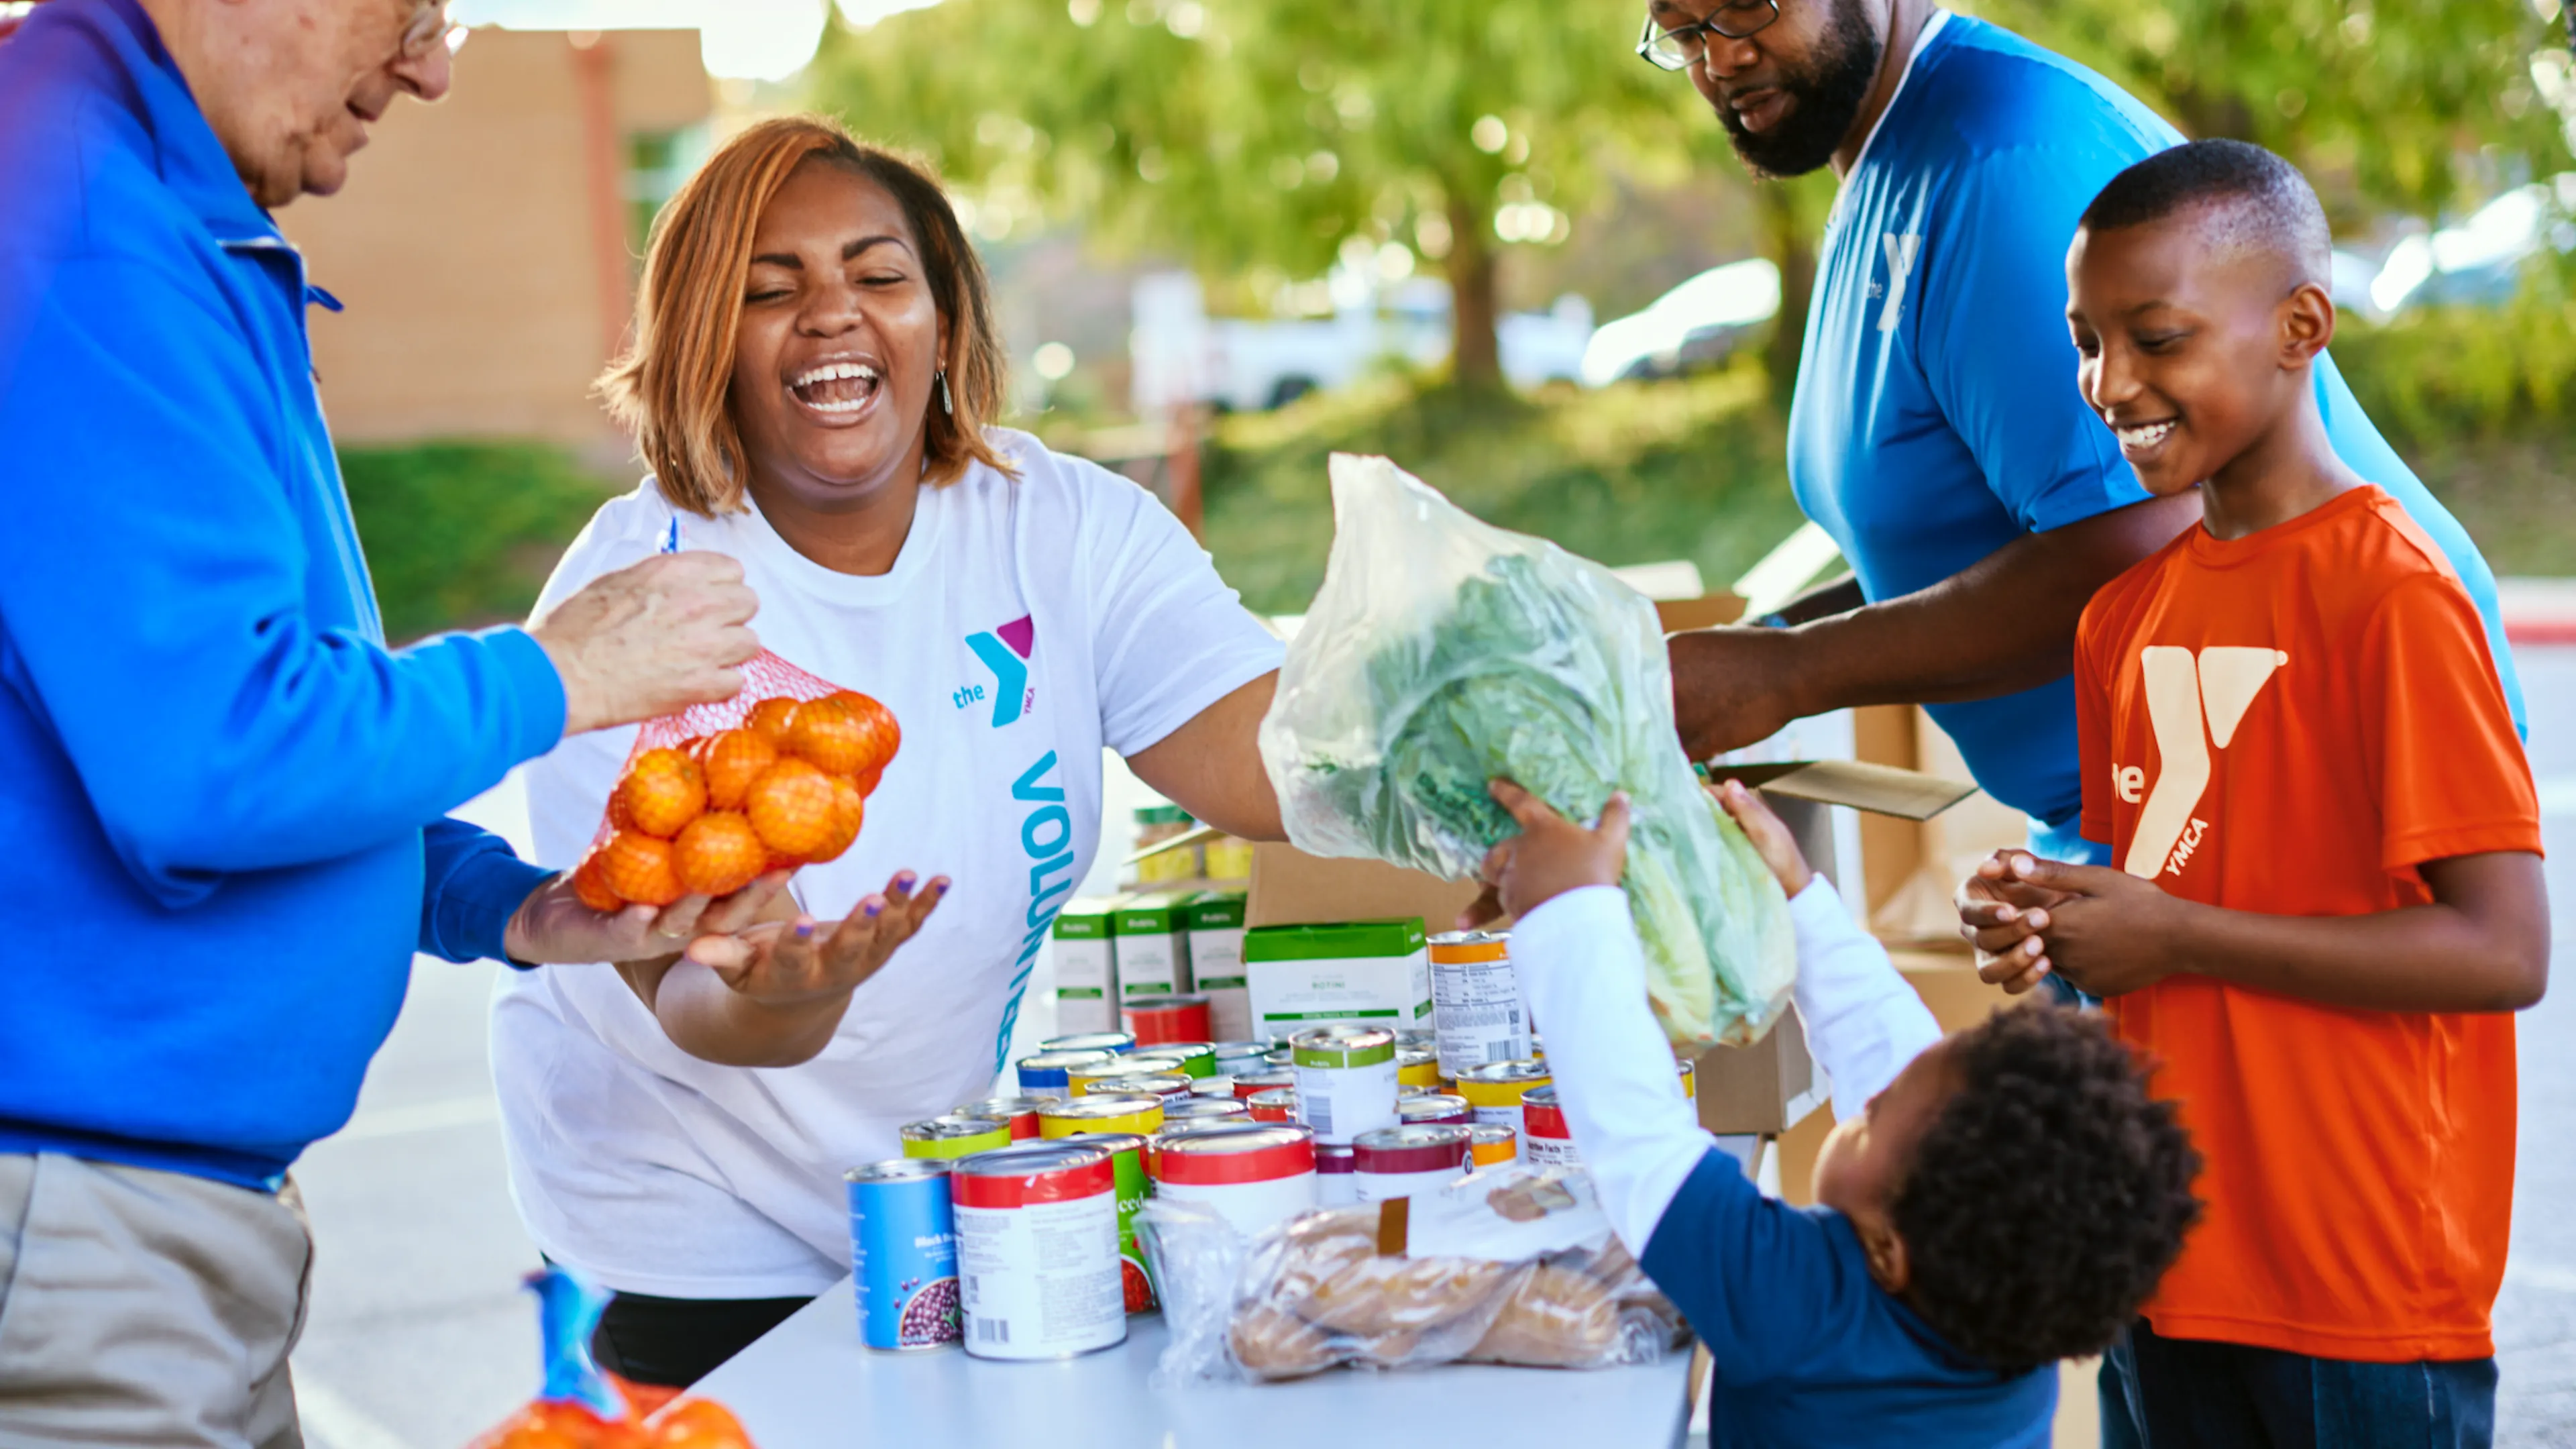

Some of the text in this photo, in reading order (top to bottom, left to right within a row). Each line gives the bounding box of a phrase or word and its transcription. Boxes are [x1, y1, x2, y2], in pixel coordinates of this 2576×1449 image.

[953, 684, 985, 709] the
[1024, 687, 1035, 714] YMCA
[2165, 817, 2208, 876] YMCA
